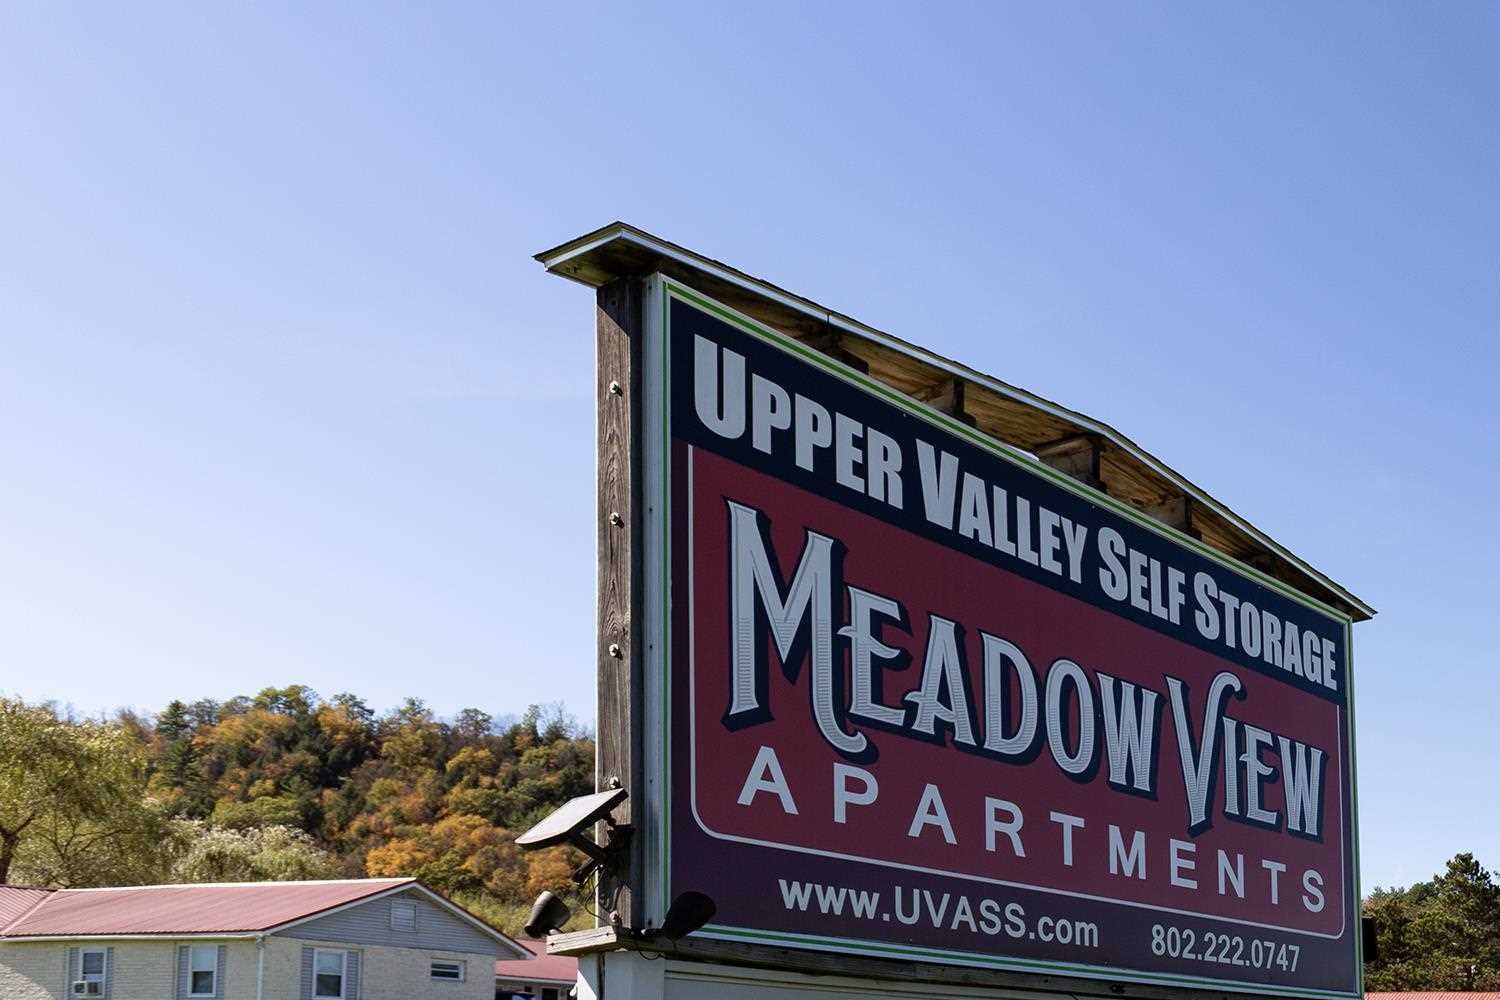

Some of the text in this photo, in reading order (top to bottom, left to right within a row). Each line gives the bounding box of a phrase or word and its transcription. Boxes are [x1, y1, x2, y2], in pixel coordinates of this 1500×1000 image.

[694, 334, 1338, 691] UPPER VALLEY SELF STORAGE
[736, 745, 1326, 914] APARTMENTS
[778, 879, 1100, 949] www.UVASS.com
[1151, 923, 1301, 973] 802.222.0747
